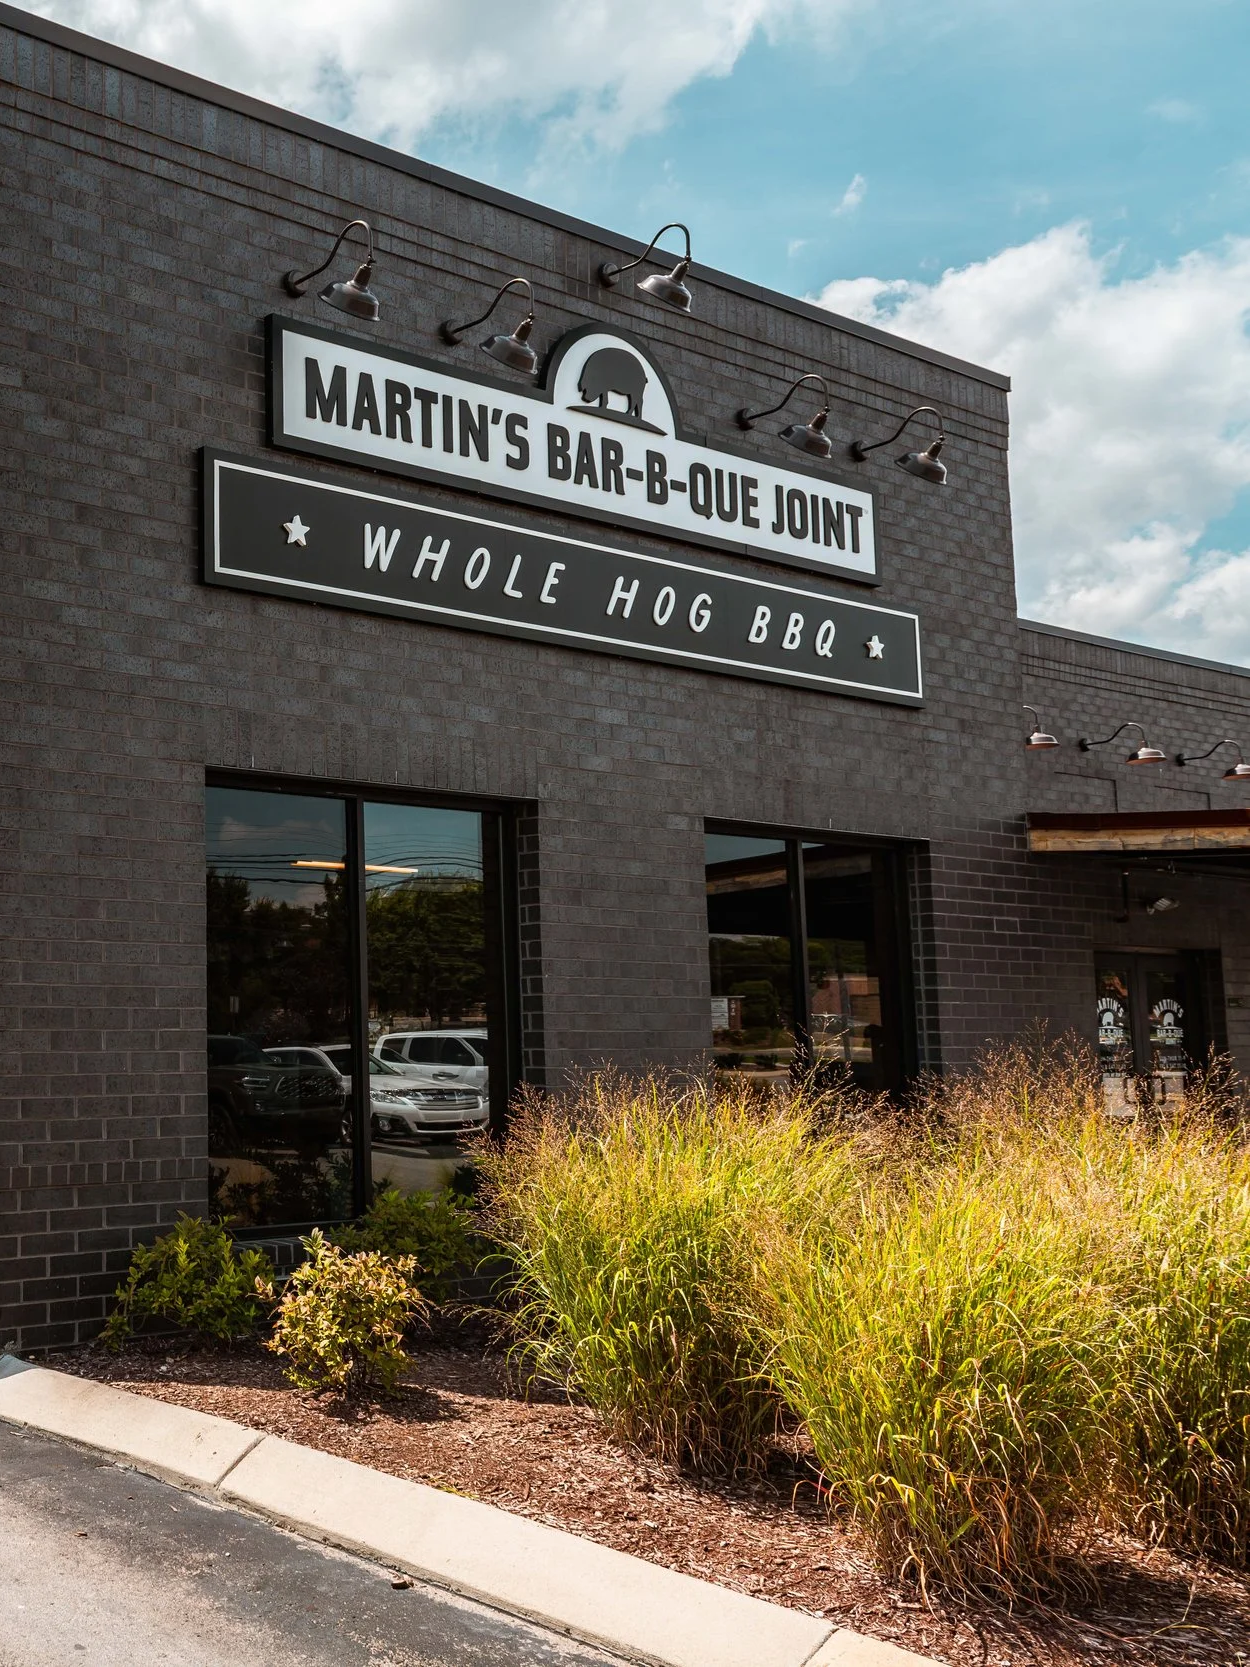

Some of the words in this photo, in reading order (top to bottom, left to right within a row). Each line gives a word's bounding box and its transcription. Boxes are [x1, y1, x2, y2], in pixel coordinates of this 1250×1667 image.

[305, 356, 530, 471] MARTIN'S
[547, 422, 760, 528] BAR-B-QUE
[771, 484, 864, 554] JOINT
[362, 522, 567, 604] WHOLE
[605, 575, 713, 634] HOG
[748, 604, 837, 660] BBQ
[1153, 999, 1184, 1018] MARTIN'S
